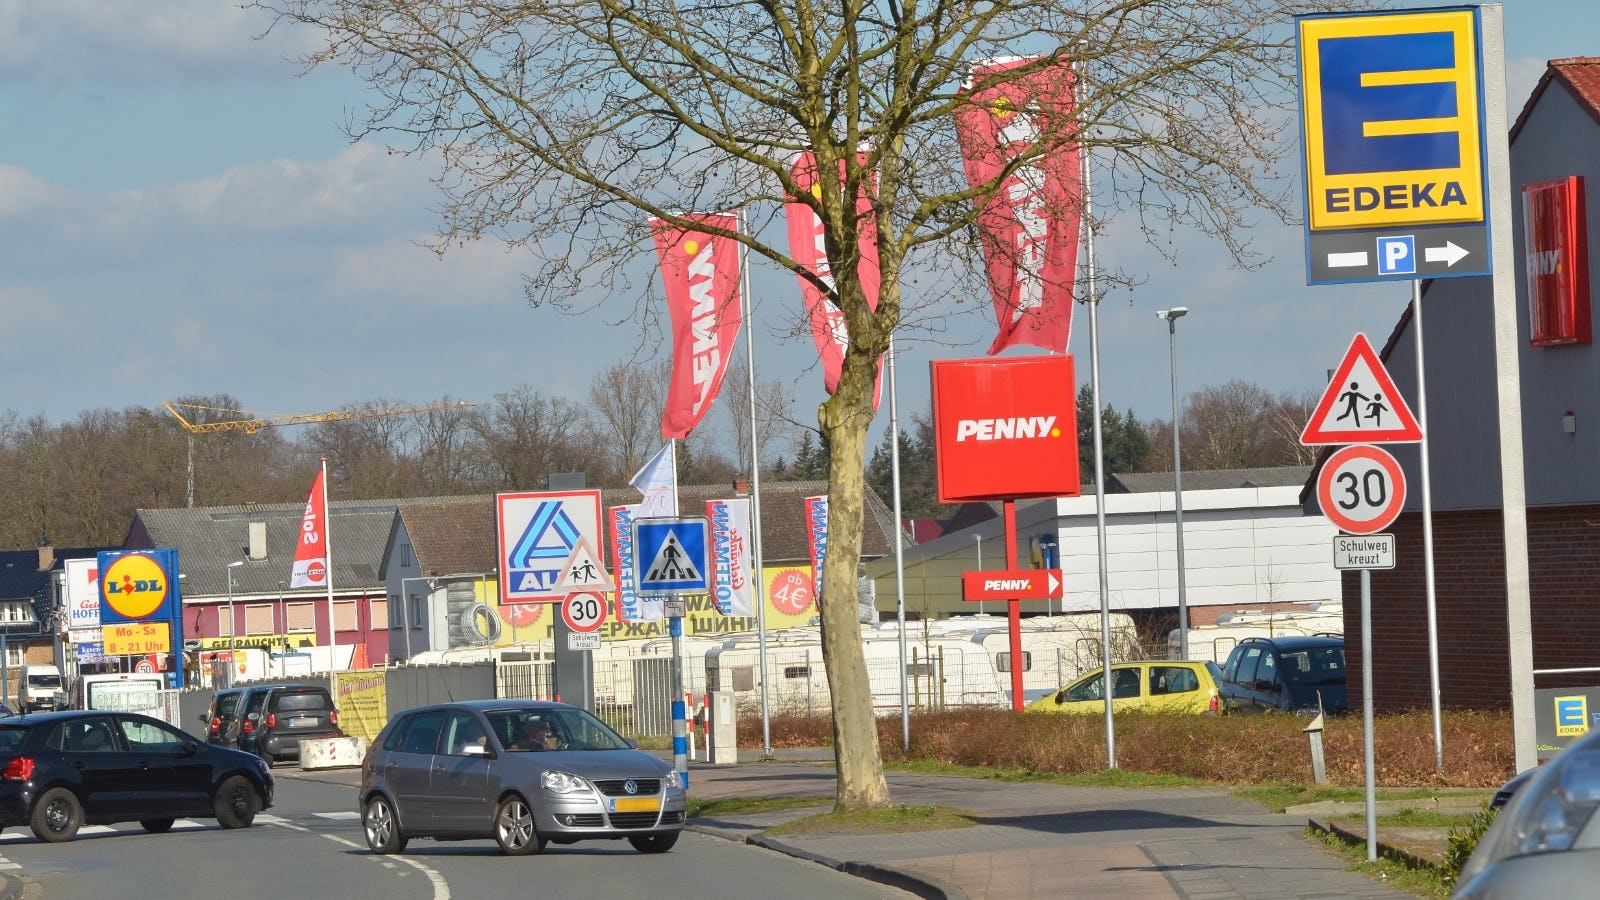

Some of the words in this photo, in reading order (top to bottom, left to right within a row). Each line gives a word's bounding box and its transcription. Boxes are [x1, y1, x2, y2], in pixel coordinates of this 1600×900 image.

[1325, 181, 1468, 213] EDEKA
[1385, 241, 1408, 270] P
[1336, 468, 1386, 510] 30
[1340, 540, 1388, 553] Schulweg
[1348, 553, 1380, 565] kreuzt
[787, 573, 803, 585] ab
[773, 583, 808, 609] 4€
[72, 609, 100, 618] HOFF
[571, 599, 598, 621] 30
[116, 627, 132, 637] Mo
[143, 626, 156, 636] Sa
[109, 643, 117, 653] 8
[128, 642, 141, 652] 21
[145, 641, 164, 651] Uhr
